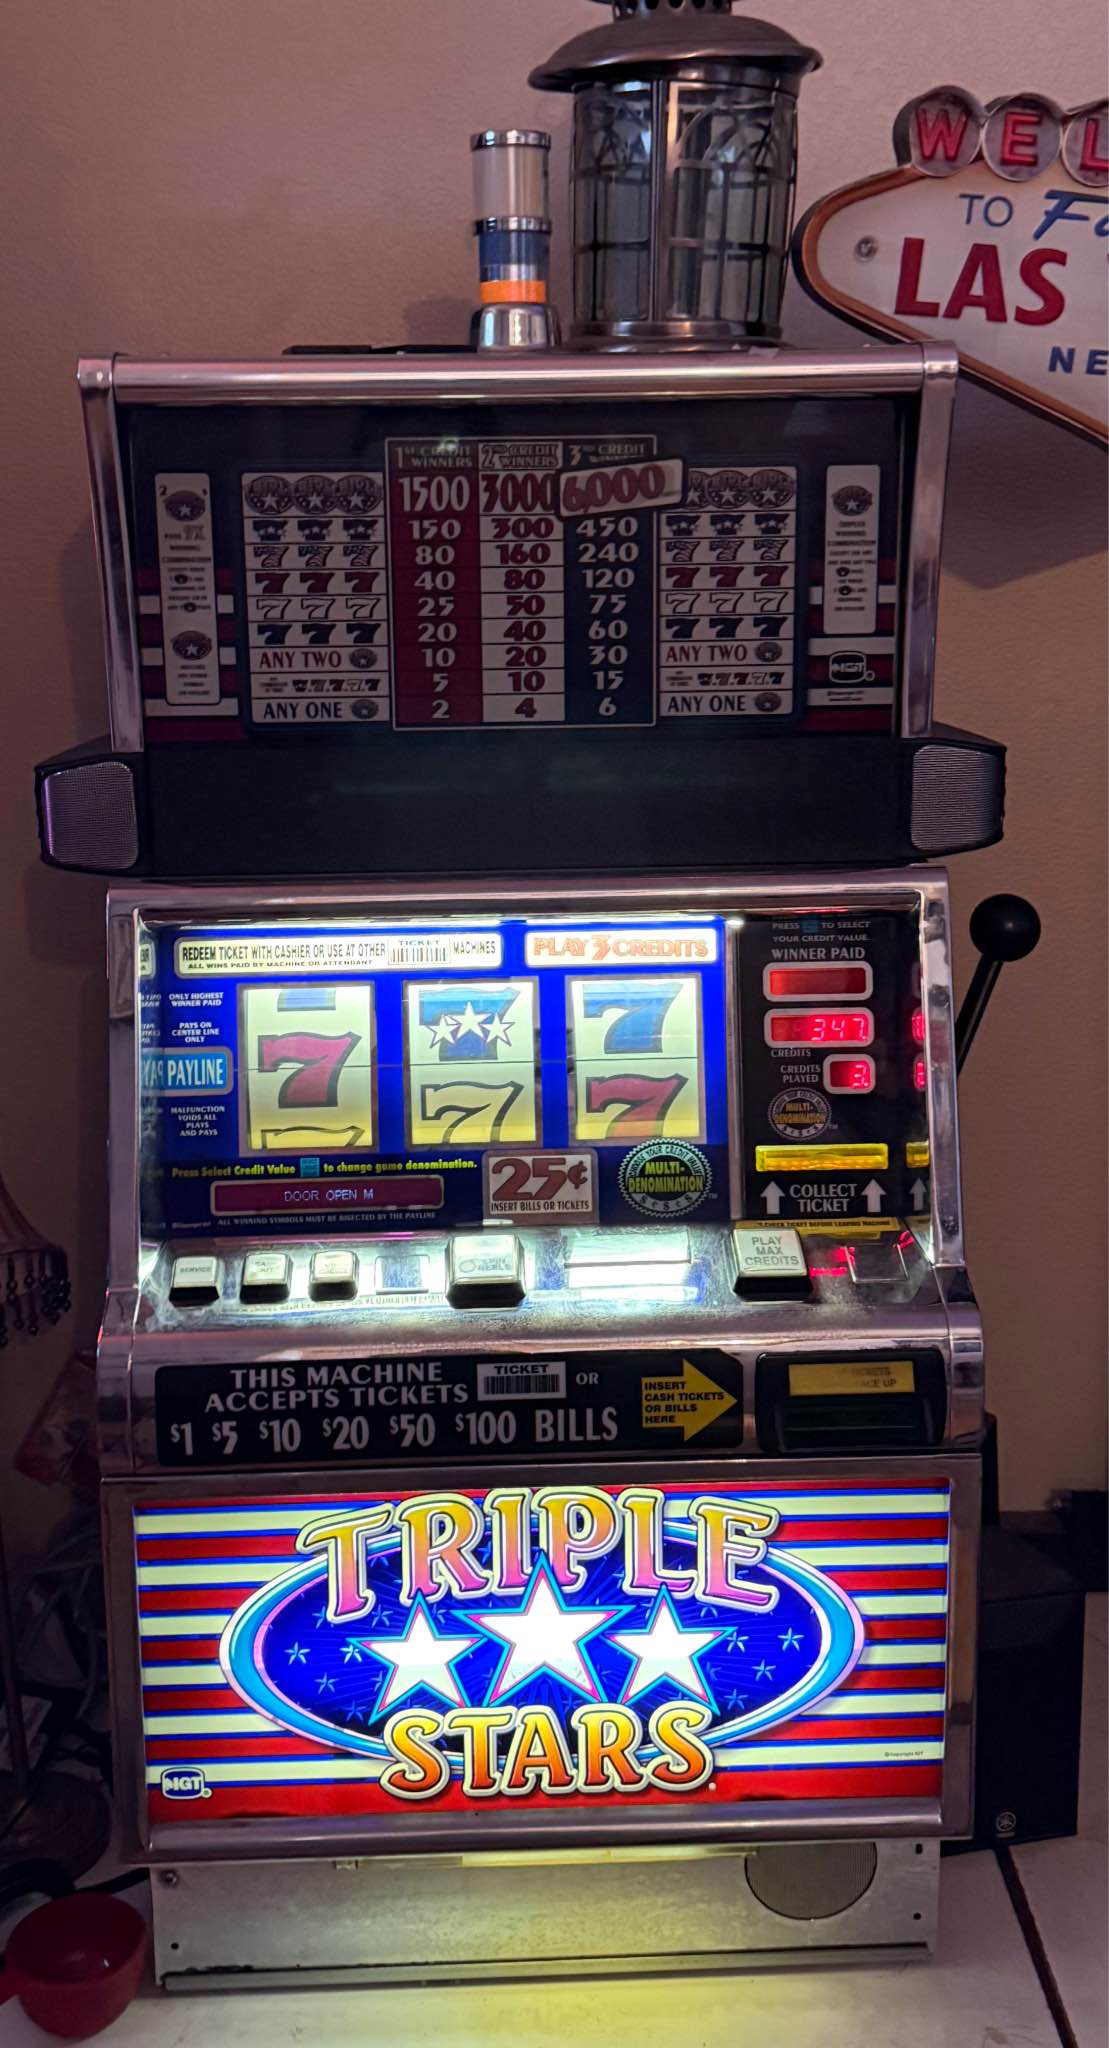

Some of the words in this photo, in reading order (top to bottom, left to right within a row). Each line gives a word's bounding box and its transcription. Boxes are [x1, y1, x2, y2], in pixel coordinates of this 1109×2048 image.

[914, 108, 1109, 172] WEL
[958, 193, 1014, 227] TO
[894, 237, 1068, 326] LAS
[1048, 346, 1109, 376] NE
[508, 444, 558, 456] CREDIT
[599, 443, 645, 455] CREDIT
[411, 456, 473, 468] WINNERS
[500, 456, 558, 468] WINNERS
[399, 476, 470, 513] 1500
[408, 519, 461, 540] 150
[491, 518, 554, 539] 300
[576, 517, 638, 537] 450
[416, 545, 455, 565] 80
[496, 543, 552, 565] 160
[577, 543, 639, 564] 240
[414, 571, 455, 590] 40
[503, 569, 546, 590] 80
[581, 568, 635, 588] 120
[417, 597, 455, 616] 25
[506, 595, 546, 616] 50
[589, 594, 627, 614] 75
[417, 623, 457, 642] 20
[503, 620, 546, 641] 40
[587, 620, 628, 639] 60
[259, 652, 300, 669] ANY
[303, 651, 342, 668] TWO
[421, 648, 455, 667] 10
[505, 646, 546, 667] 20
[587, 645, 628, 665] 30
[665, 645, 705, 662] ANY
[707, 644, 748, 661] TWO
[433, 673, 449, 692] 5
[508, 671, 546, 691] 10
[591, 671, 624, 690] 15
[263, 703, 299, 719] ANY
[305, 702, 342, 718] ONE
[432, 700, 449, 719] 2
[514, 697, 537, 718] 4
[598, 697, 617, 716] 6
[667, 696, 704, 712] ANY
[709, 695, 747, 711] ONE
[182, 946, 217, 961] REDEEM
[219, 946, 248, 960] TICKET
[252, 945, 272, 960] WITH
[275, 944, 311, 959] CASHIER
[313, 944, 325, 958] OR
[327, 944, 343, 958] USE
[346, 943, 357, 957] AT
[358, 943, 386, 957] OTHER
[453, 940, 496, 955] MACHINES
[533, 938, 591, 957] PLAY
[591, 934, 612, 961] 3
[612, 938, 709, 957] CREDITS
[771, 949, 826, 960] WINNER
[831, 948, 866, 959] PAID
[203, 999, 222, 1007] PAID
[771, 1049, 811, 1057] CREDITS
[167, 1059, 224, 1086] PAYLINE
[780, 1065, 821, 1073] CREDITS
[783, 1074, 819, 1083] PLAYED
[170, 1106, 225, 1114] MALFUNCTION
[172, 1167, 199, 1177] Press
[202, 1166, 231, 1176] Select
[234, 1165, 264, 1176] Credit
[267, 1163, 295, 1174] Value
[324, 1163, 334, 1172] to
[337, 1162, 372, 1173] change
[376, 1163, 402, 1173] game
[406, 1158, 477, 1170] denomination.
[645, 1161, 686, 1175] MULTI-
[491, 1157, 588, 1201] 25¢
[628, 1176, 704, 1193] DENOMINATION
[284, 1190, 319, 1201] DOOR
[326, 1189, 357, 1200] OPEN
[789, 1184, 858, 1198] COLLECT
[491, 1201, 518, 1212] INSERT
[519, 1201, 542, 1211] BILLS
[543, 1201, 556, 1210] OR
[557, 1200, 590, 1211] TICKETS
[798, 1199, 850, 1212] TICKET
[752, 1236, 783, 1246] PLAY
[756, 1246, 785, 1255] MAX
[745, 1255, 799, 1266] CREDITS
[231, 1368, 295, 1389] THIS
[307, 1362, 443, 1387] MACHINE
[205, 1389, 340, 1413] ACCEPTS
[350, 1384, 468, 1408] TICKETS
[494, 1364, 549, 1374] TICKET
[576, 1373, 599, 1385] OR
[644, 1381, 687, 1391] INSERT
[645, 1392, 675, 1402] CASH
[678, 1391, 725, 1401] TICKETS
[645, 1404, 661, 1413] OR
[665, 1403, 698, 1413] BILLS
[645, 1415, 676, 1424] HERE
[171, 1423, 193, 1456] $1
[213, 1421, 238, 1455] $5
[259, 1418, 301, 1453] $10
[323, 1416, 370, 1450] $20
[390, 1413, 436, 1448] $50
[455, 1410, 517, 1446] $100
[535, 1407, 618, 1442] BILLS
[295, 1486, 782, 1626] TRIPLE
[380, 1701, 714, 1797] STARS
